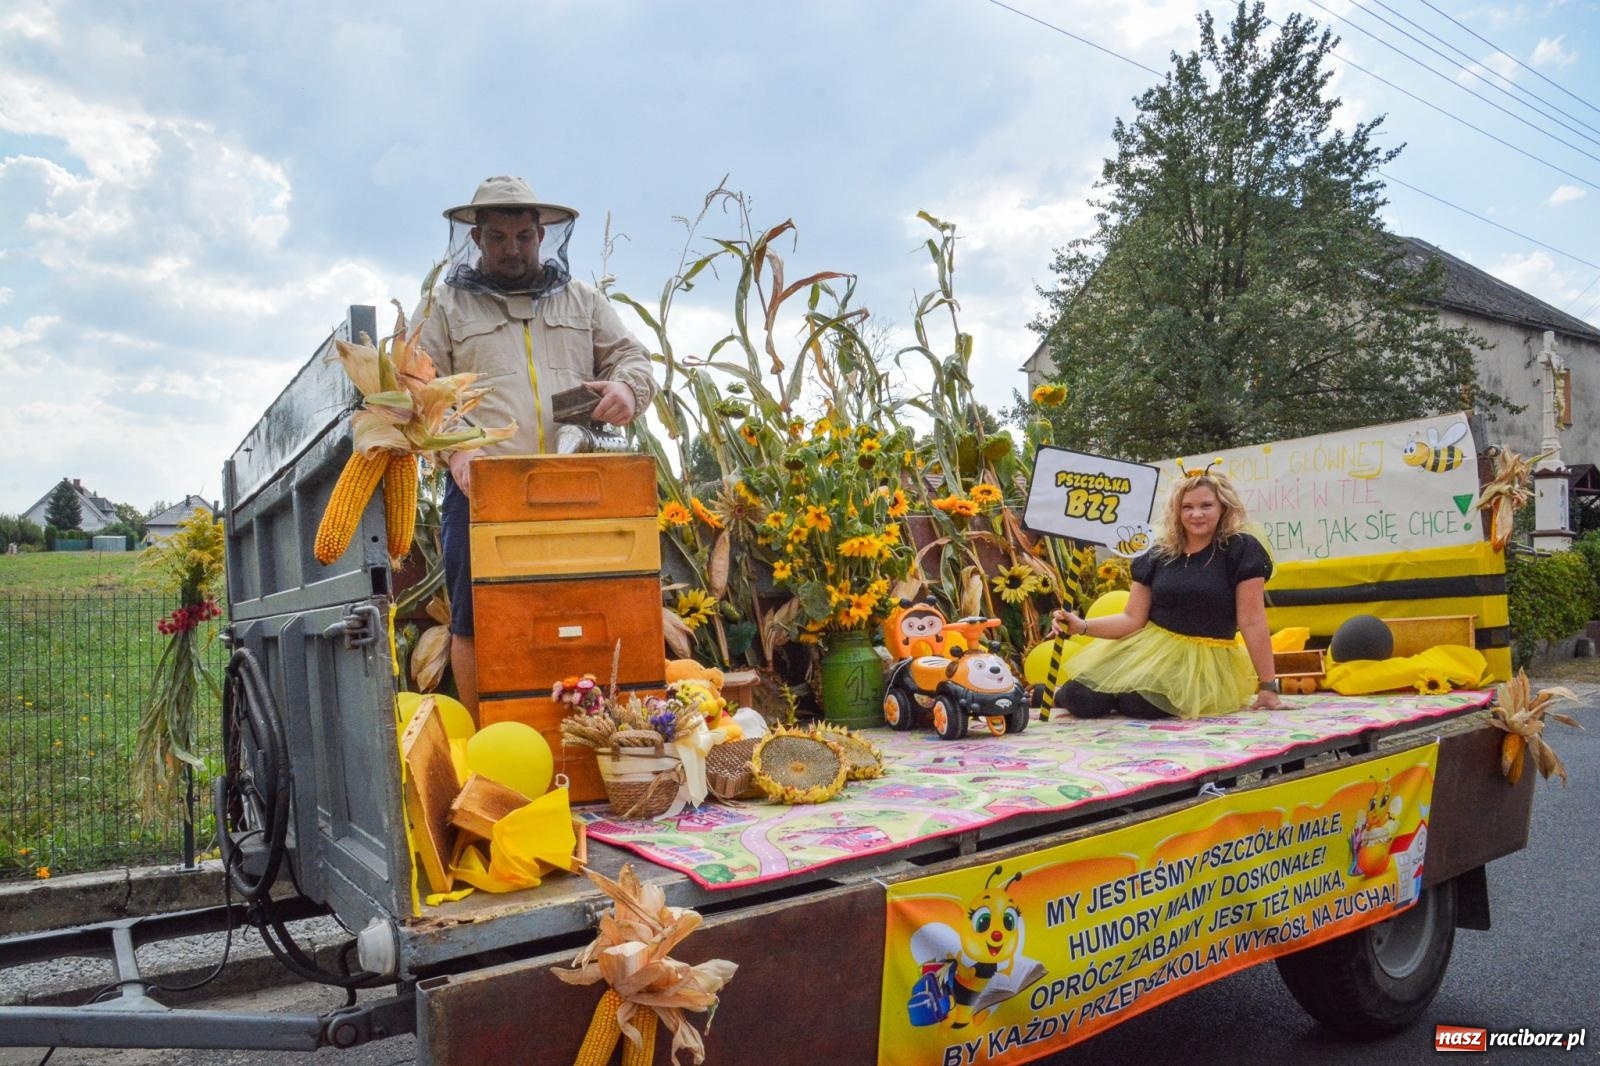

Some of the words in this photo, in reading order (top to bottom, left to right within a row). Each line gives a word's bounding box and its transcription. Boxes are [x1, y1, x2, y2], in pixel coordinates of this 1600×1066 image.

[1055, 470, 1131, 494] PSZCZÓŁKA
[1064, 488, 1120, 524] BZZ
[1313, 480, 1328, 508] W
[1338, 478, 1381, 505] TLE
[1314, 516, 1359, 558] JAK
[1366, 510, 1400, 544] SIĘ
[1047, 893, 1080, 927] MY
[1086, 856, 1197, 914] JESTEŚMY
[1199, 825, 1293, 873] PSZCZÓŁKI
[1297, 813, 1342, 844] MAŁE,
[1069, 905, 1163, 960] HUMORY
[1165, 880, 1217, 922] MAMY
[1220, 846, 1326, 897] DOSKONAŁE!
[943, 1038, 984, 1066] BY
[988, 1010, 1076, 1058] KAŻDY
[1234, 918, 1309, 955] WYRÓSŁ
[1312, 905, 1334, 929] NA
[1334, 883, 1396, 922] ZUCHA!
[1030, 956, 1126, 1011] OPRÓCZ
[1127, 906, 1204, 971] ZABAWY
[1208, 901, 1258, 933] JEST
[1262, 886, 1289, 918] TEŻ
[1293, 870, 1345, 905] NAUKA,
